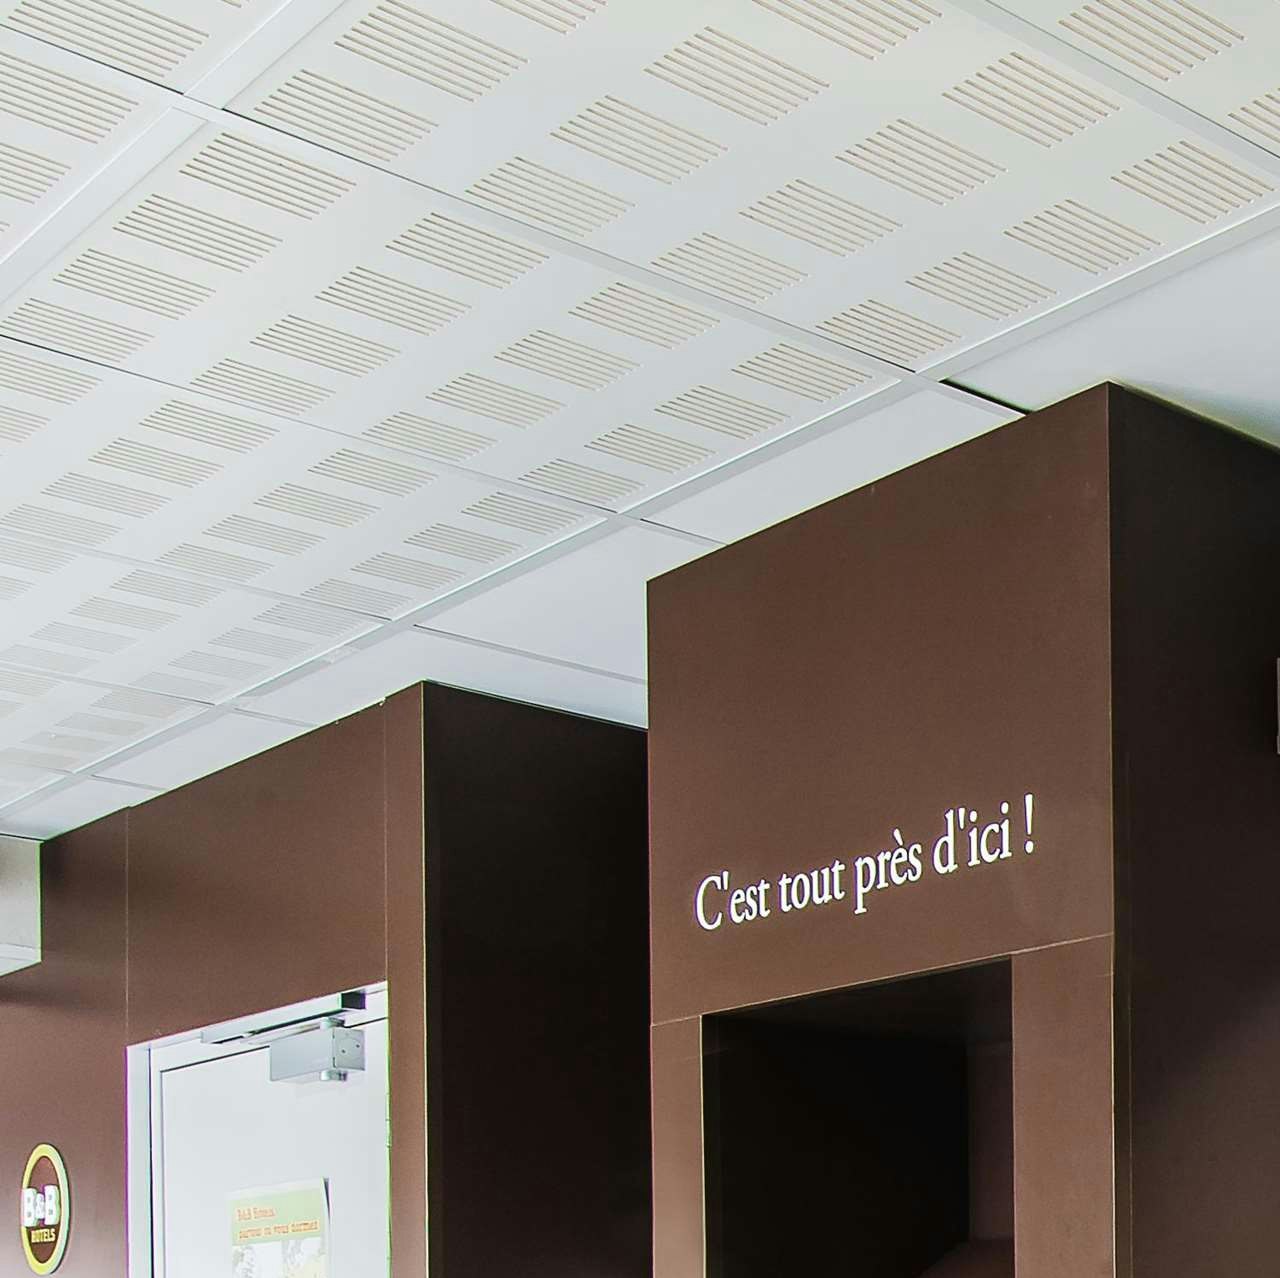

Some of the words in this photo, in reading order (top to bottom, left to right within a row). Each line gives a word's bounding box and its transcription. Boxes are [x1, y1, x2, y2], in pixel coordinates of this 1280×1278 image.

[695, 870, 771, 931] C'est
[779, 858, 845, 912] tout
[854, 828, 922, 915] près
[933, 800, 1012, 875] d'ici
[22, 1184, 60, 1228] B&B
